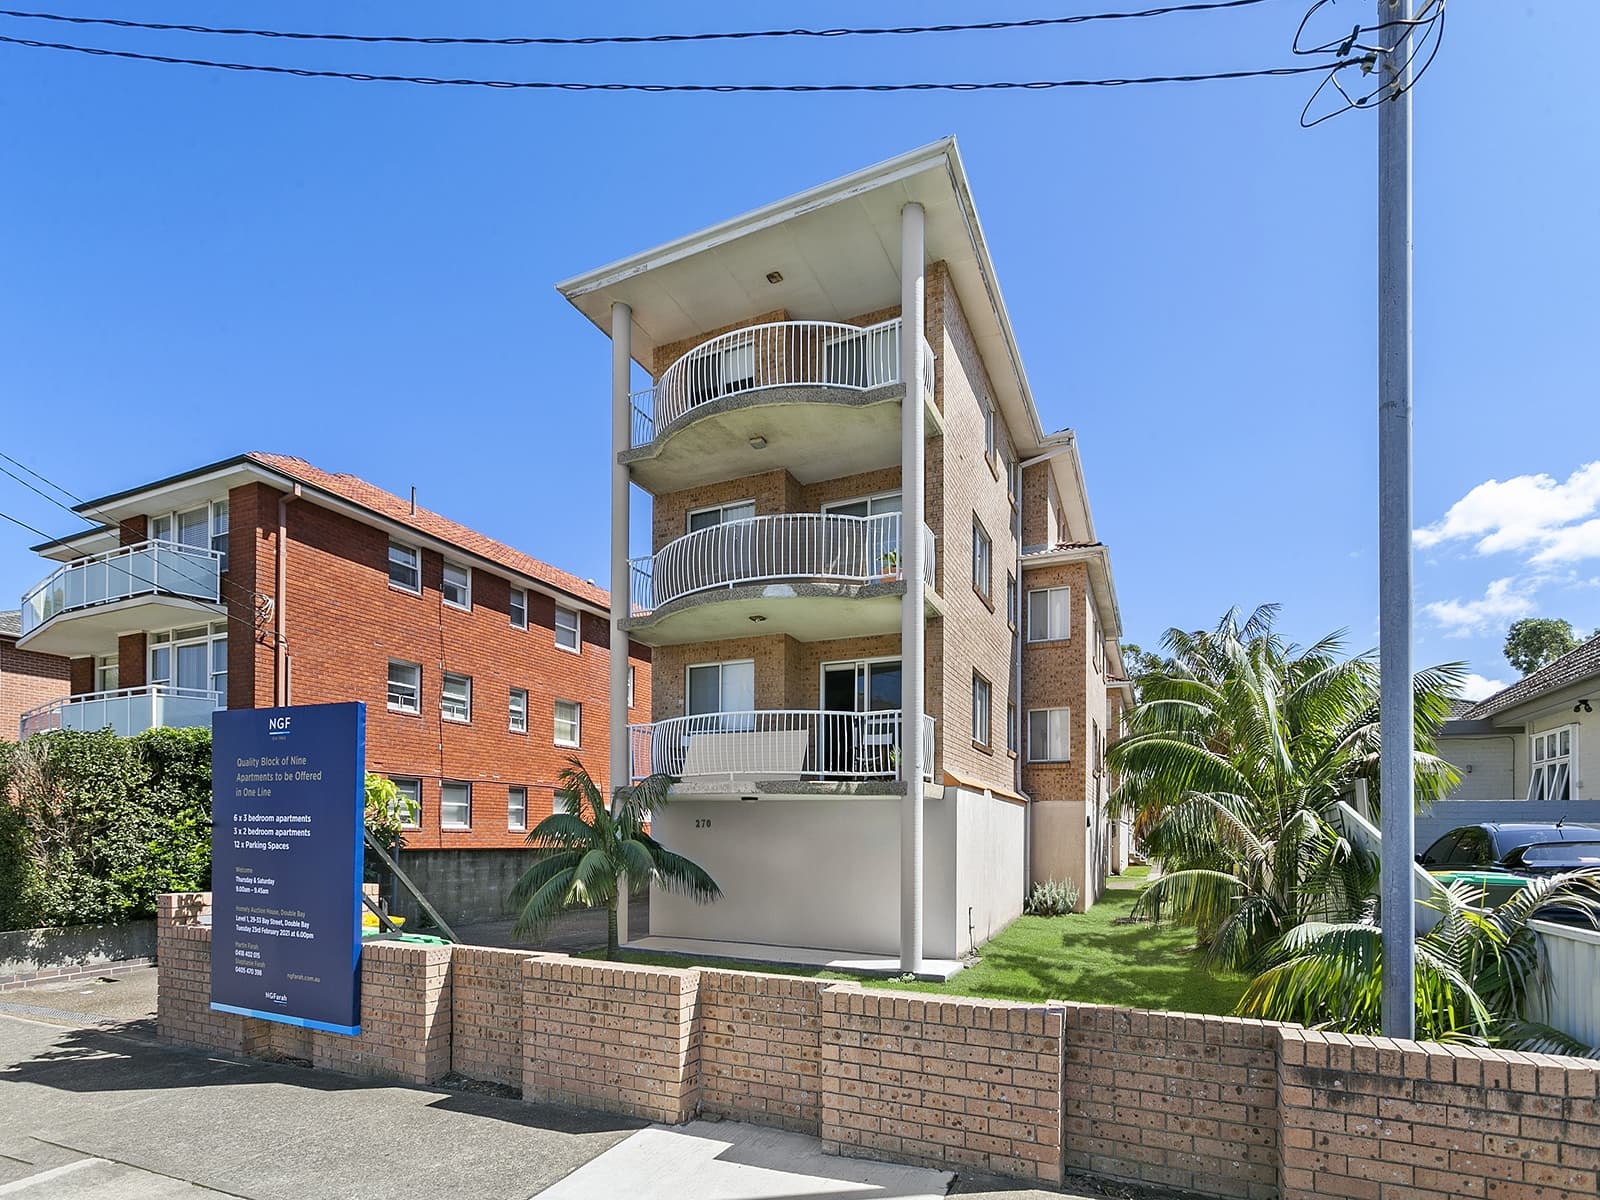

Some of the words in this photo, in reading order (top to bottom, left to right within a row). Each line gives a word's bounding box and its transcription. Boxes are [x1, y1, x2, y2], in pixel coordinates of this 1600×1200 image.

[269, 717, 291, 730] NGF
[236, 758, 260, 768] Quality
[260, 756, 280, 766] Block
[281, 756, 288, 766] of
[290, 756, 306, 766] Nine
[236, 772, 274, 782] Apartments
[275, 772, 282, 781] to
[284, 771, 293, 781] be
[294, 771, 322, 780] Offered
[236, 788, 242, 797] in
[243, 788, 256, 797] One
[258, 788, 272, 797] Line
[248, 814, 274, 822] bedroom
[276, 815, 312, 823] apartments
[696, 819, 711, 828] 270
[248, 828, 274, 836] bedroom
[275, 828, 310, 837] apartments
[246, 841, 266, 850] Parking
[268, 842, 290, 850] Spaces
[297, 910, 305, 919] Bay
[270, 918, 284, 926] Street,
[284, 920, 300, 928] Double
[301, 921, 310, 929] Bay
[236, 924, 251, 933] Tuesday
[262, 927, 279, 936] February
[296, 931, 314, 939] 6.00pm
[265, 992, 288, 1001] NGFarah
